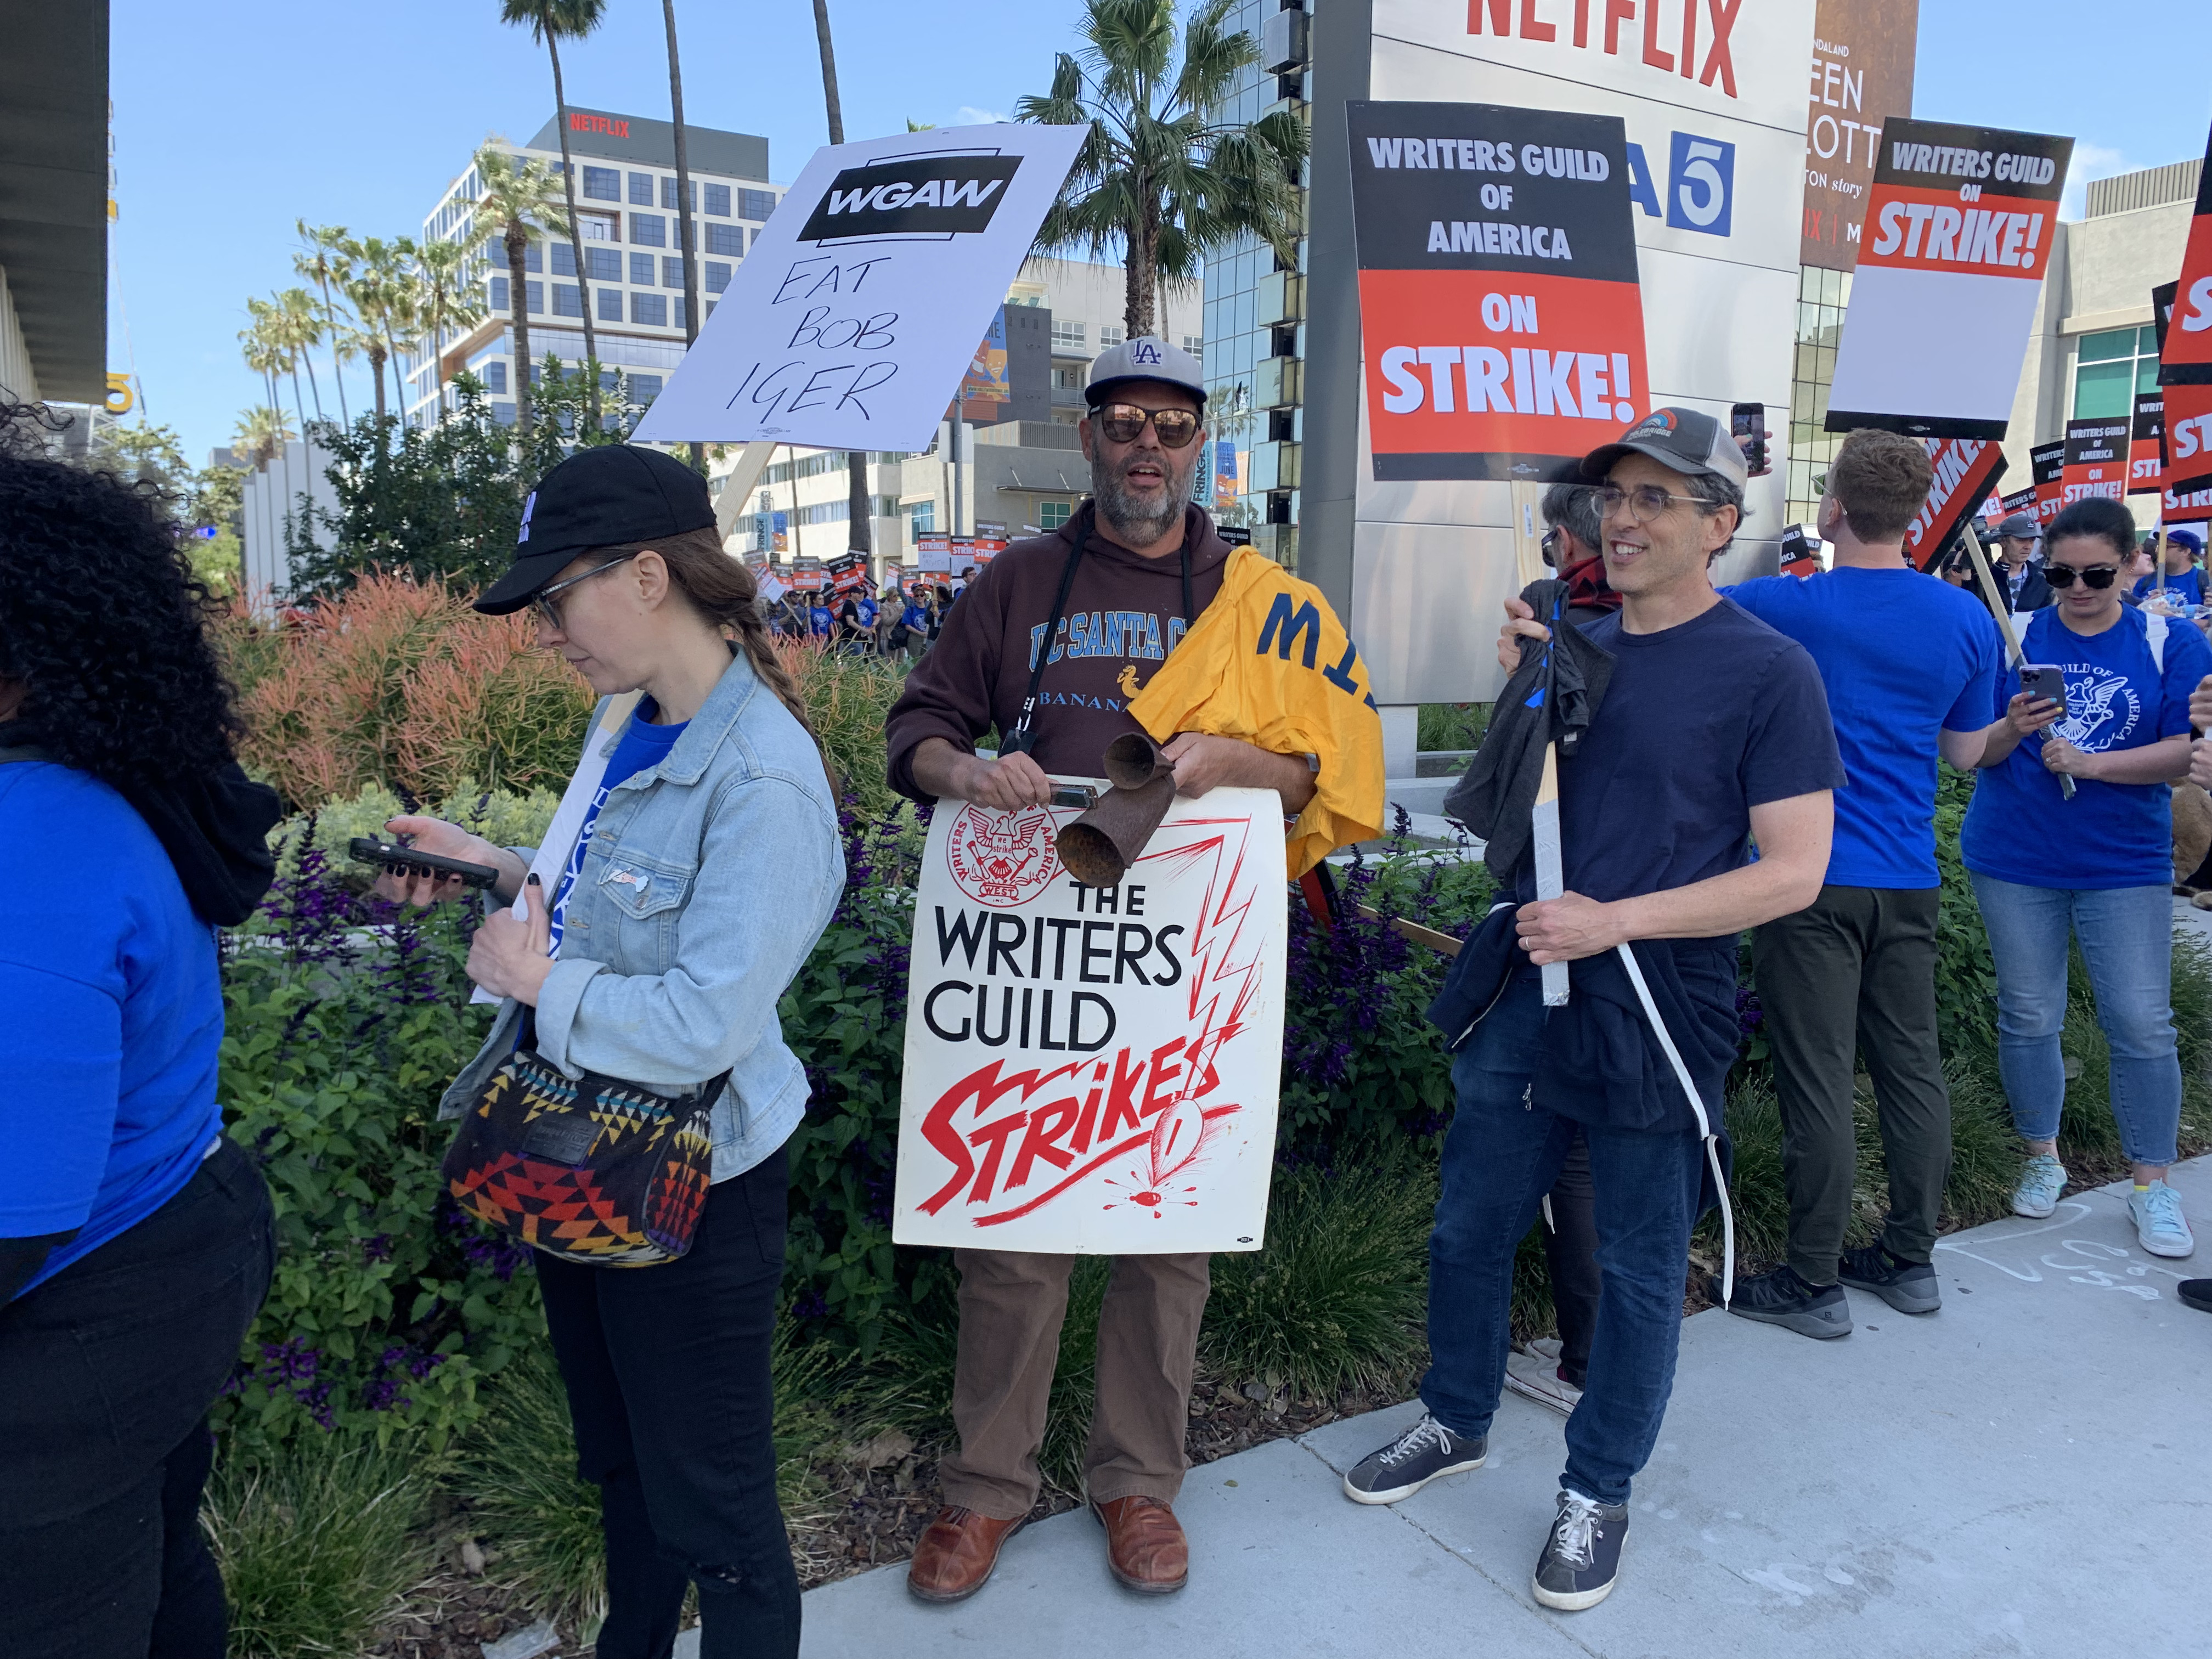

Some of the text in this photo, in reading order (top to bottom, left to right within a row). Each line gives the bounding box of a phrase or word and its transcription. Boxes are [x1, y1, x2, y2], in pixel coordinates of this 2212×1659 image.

[571, 114, 629, 138] NETFLIX
[1806, 115, 1882, 168] OTT
[1367, 137, 1610, 182] WRITERS GUILD
[1893, 142, 2055, 185] WRITERS GUILD
[827, 179, 1004, 216] WGAW
[1481, 184, 1513, 210] OF
[1679, 140, 1724, 227] 5
[1832, 178, 1863, 199] story
[1960, 184, 1982, 202] ON
[1427, 221, 1573, 260] AMERICA
[1873, 201, 2045, 269] STRIKE!
[772, 256, 891, 305] EAT
[788, 306, 899, 350] BOB
[985, 321, 1000, 338] NE
[1482, 292, 1538, 333] ON
[1132, 339, 1162, 365] LA
[726, 362, 899, 424] IGER
[1380, 346, 1635, 424] STRIKE!
[2070, 425, 2126, 439] WRITERS GUILD
[2093, 439, 2102, 448] OF
[1220, 465, 1234, 474] JUNE
[2079, 449, 2113, 460] AMERICA
[2064, 480, 2121, 503] STRIKE!
[2089, 469, 2102, 480] ON
[919, 541, 947, 550] STRIKE!
[1067, 611, 1164, 660] SANTA
[1039, 691, 1131, 713] BANAN
[2093, 667, 2113, 677] OF
[2115, 689, 2140, 741] AMERICA
[952, 821, 1055, 884] WRITERS AMERICA
[993, 845, 1012, 854] strike
[984, 887, 1014, 897] WEST
[1069, 881, 1144, 917] THE
[935, 906, 1185, 987] WRITERS
[924, 980, 1116, 1052] GUILD
